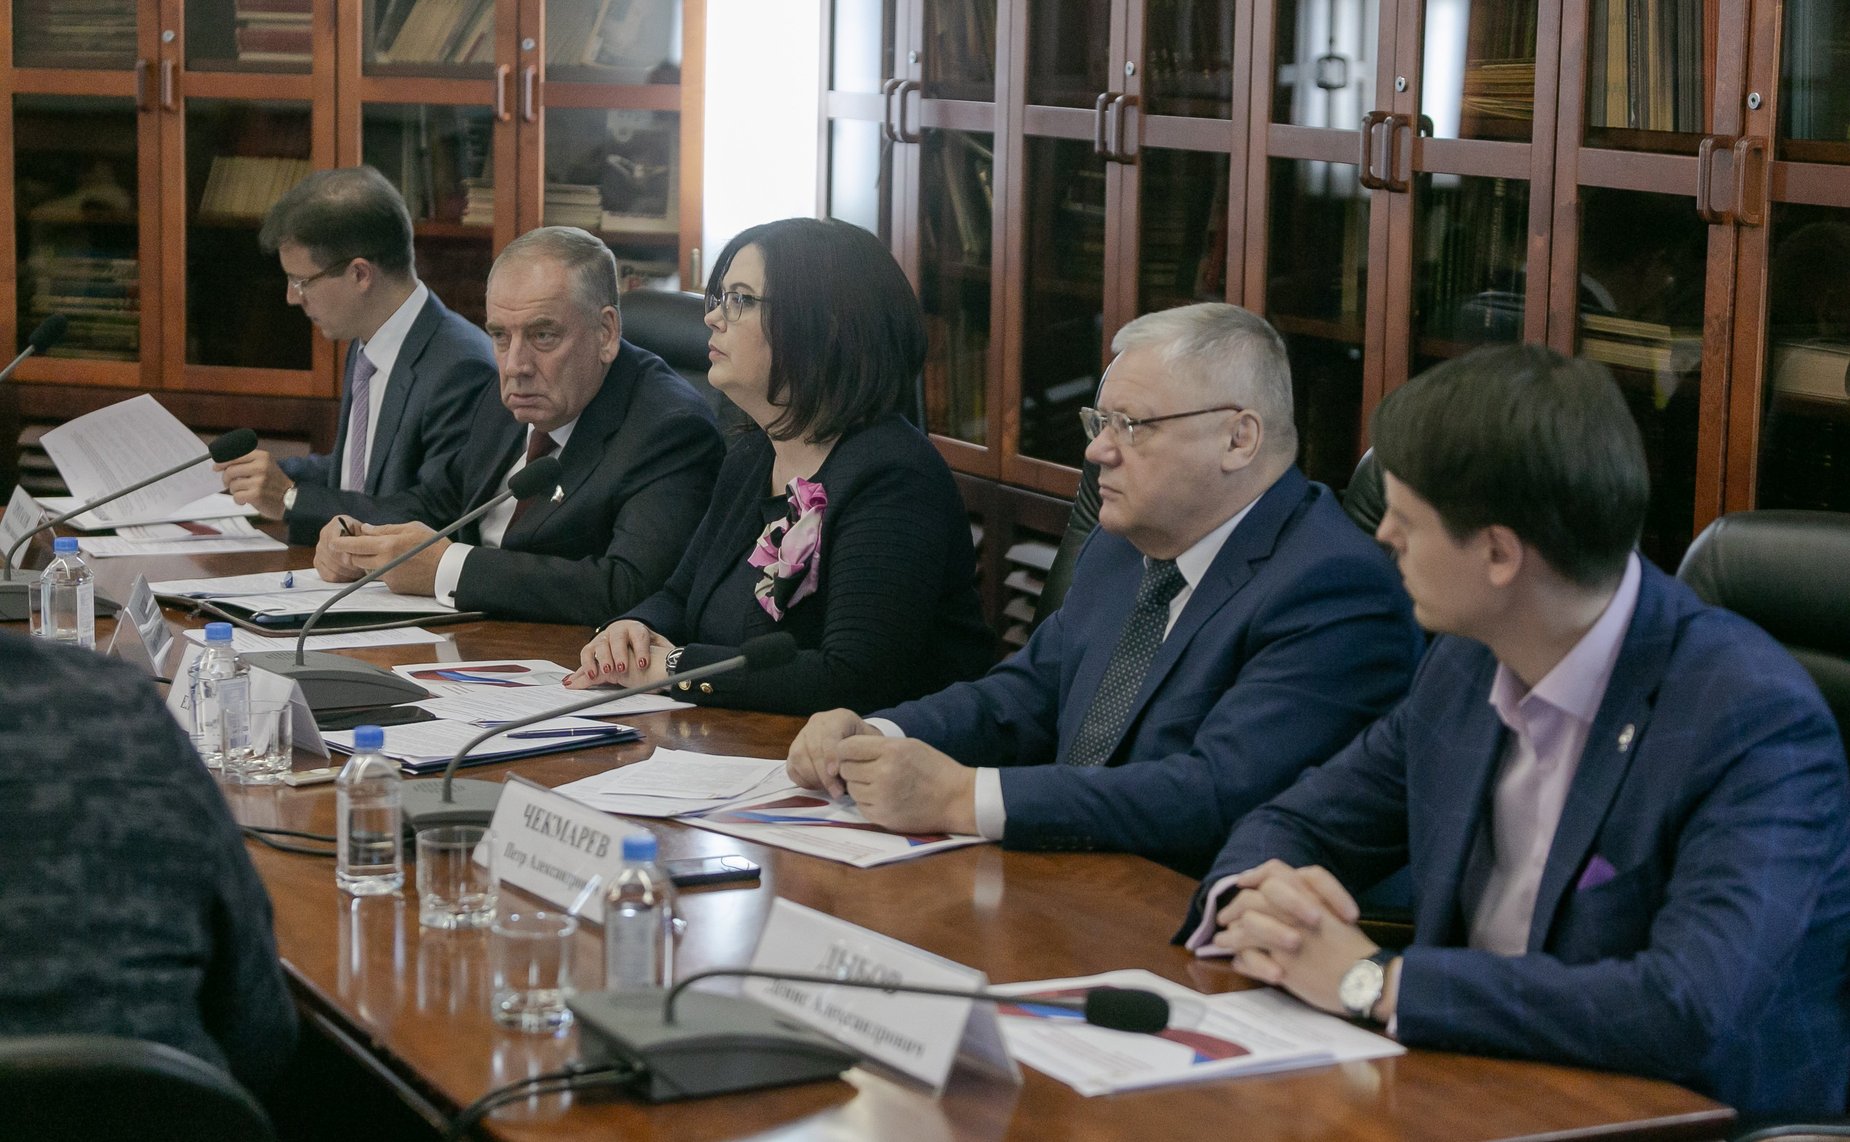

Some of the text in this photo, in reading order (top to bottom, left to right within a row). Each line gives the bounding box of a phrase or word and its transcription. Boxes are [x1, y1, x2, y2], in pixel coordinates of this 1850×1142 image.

[524, 803, 611, 858] ЧЕКМАРЕВ
[503, 841, 599, 896] Петр Александровч
